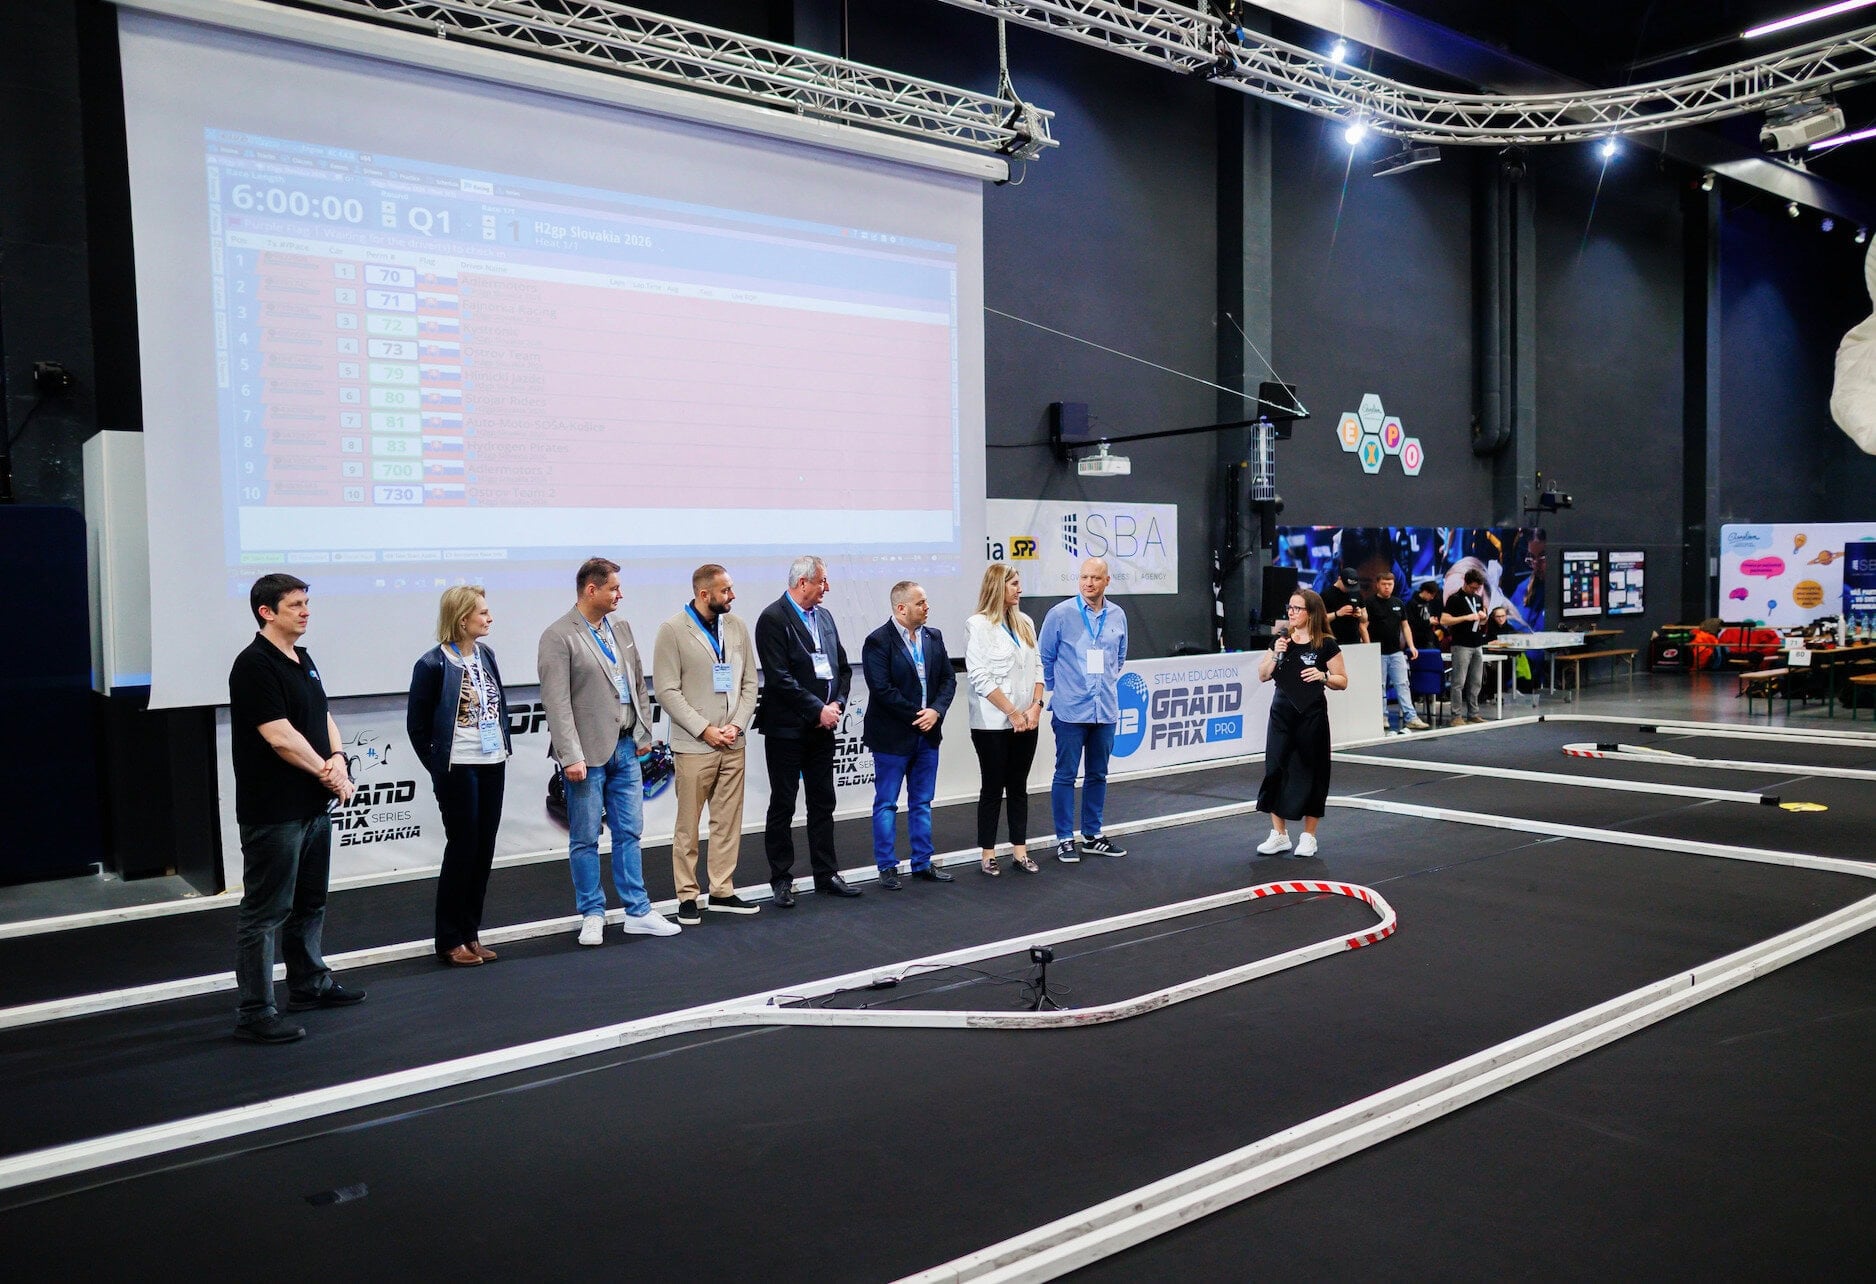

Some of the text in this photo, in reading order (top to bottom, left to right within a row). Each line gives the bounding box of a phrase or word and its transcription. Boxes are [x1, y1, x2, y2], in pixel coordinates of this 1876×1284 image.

[231, 184, 364, 223] 6:00:00
[408, 207, 450, 237] Q1
[507, 220, 520, 242] 1
[535, 221, 653, 249] H2gp Slovakia 2026
[236, 256, 243, 267] 1
[341, 267, 347, 276] 1
[380, 270, 401, 283] 70
[236, 281, 245, 293] 2
[342, 293, 348, 301] 2
[380, 294, 401, 307] 71
[237, 306, 247, 319] 3
[343, 317, 350, 326] 3
[382, 318, 403, 332] 72
[238, 332, 248, 345] 4
[344, 342, 351, 351] 4
[382, 343, 403, 356] 73
[509, 349, 541, 361] Team
[240, 358, 249, 371] 5
[345, 367, 352, 376] 5
[384, 367, 405, 380] 79
[241, 384, 250, 397] 6
[346, 392, 353, 401] 6
[384, 391, 405, 404] 80
[242, 409, 252, 423] 7
[347, 417, 354, 425] 7
[385, 416, 405, 428] 81
[243, 435, 253, 448] 8
[348, 441, 354, 450] 8
[386, 440, 407, 452] 83
[244, 461, 254, 474] 9
[349, 466, 355, 474] 9
[383, 464, 413, 476] 700
[241, 486, 261, 499] 10
[348, 491, 360, 499] 10
[383, 489, 414, 501] 730
[1085, 514, 1166, 558] SBA
[1012, 540, 1036, 556] SPP
[1112, 573, 1130, 581] NESS
[1141, 572, 1166, 580] AGENCY
[1154, 666, 1239, 685] STEAM EDUCATION
[1151, 682, 1243, 720] GRAND
[1151, 718, 1206, 750] PRIX
[1214, 721, 1236, 736] PRO
[832, 756, 874, 774] RIX SER
[837, 774, 875, 787] SLOVA
[331, 808, 412, 830] RIX SERIES
[340, 825, 420, 847] SLOVAKIA
